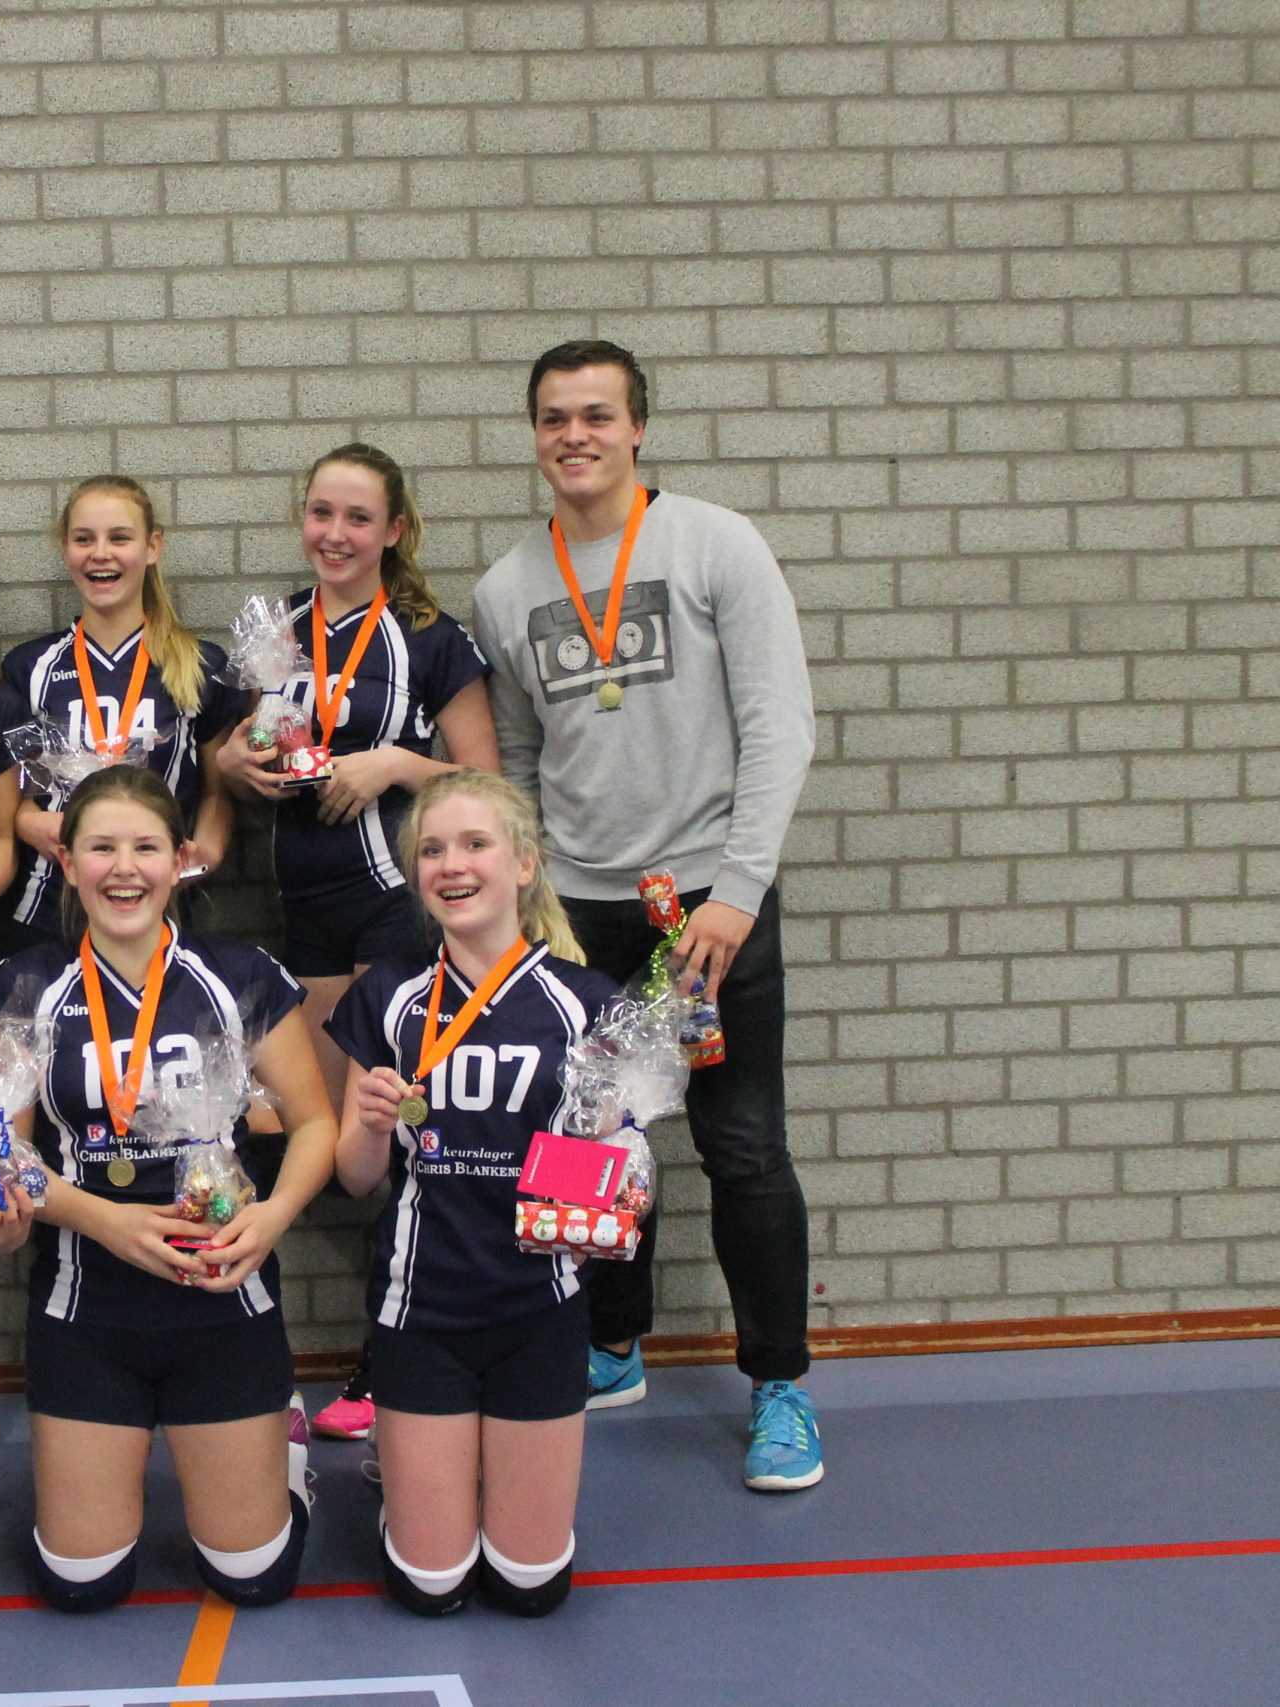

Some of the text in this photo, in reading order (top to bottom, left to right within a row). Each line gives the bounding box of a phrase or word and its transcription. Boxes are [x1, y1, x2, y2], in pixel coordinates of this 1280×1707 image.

[51, 669, 79, 683] Dint
[67, 695, 158, 752] 104
[62, 1003, 89, 1017] Din
[411, 1004, 454, 1023] Dito
[82, 1033, 204, 1110] 102
[430, 1044, 541, 1113] 107
[442, 1145, 515, 1162] keurslager
[416, 1160, 522, 1177] CHRIS BLANKEND
